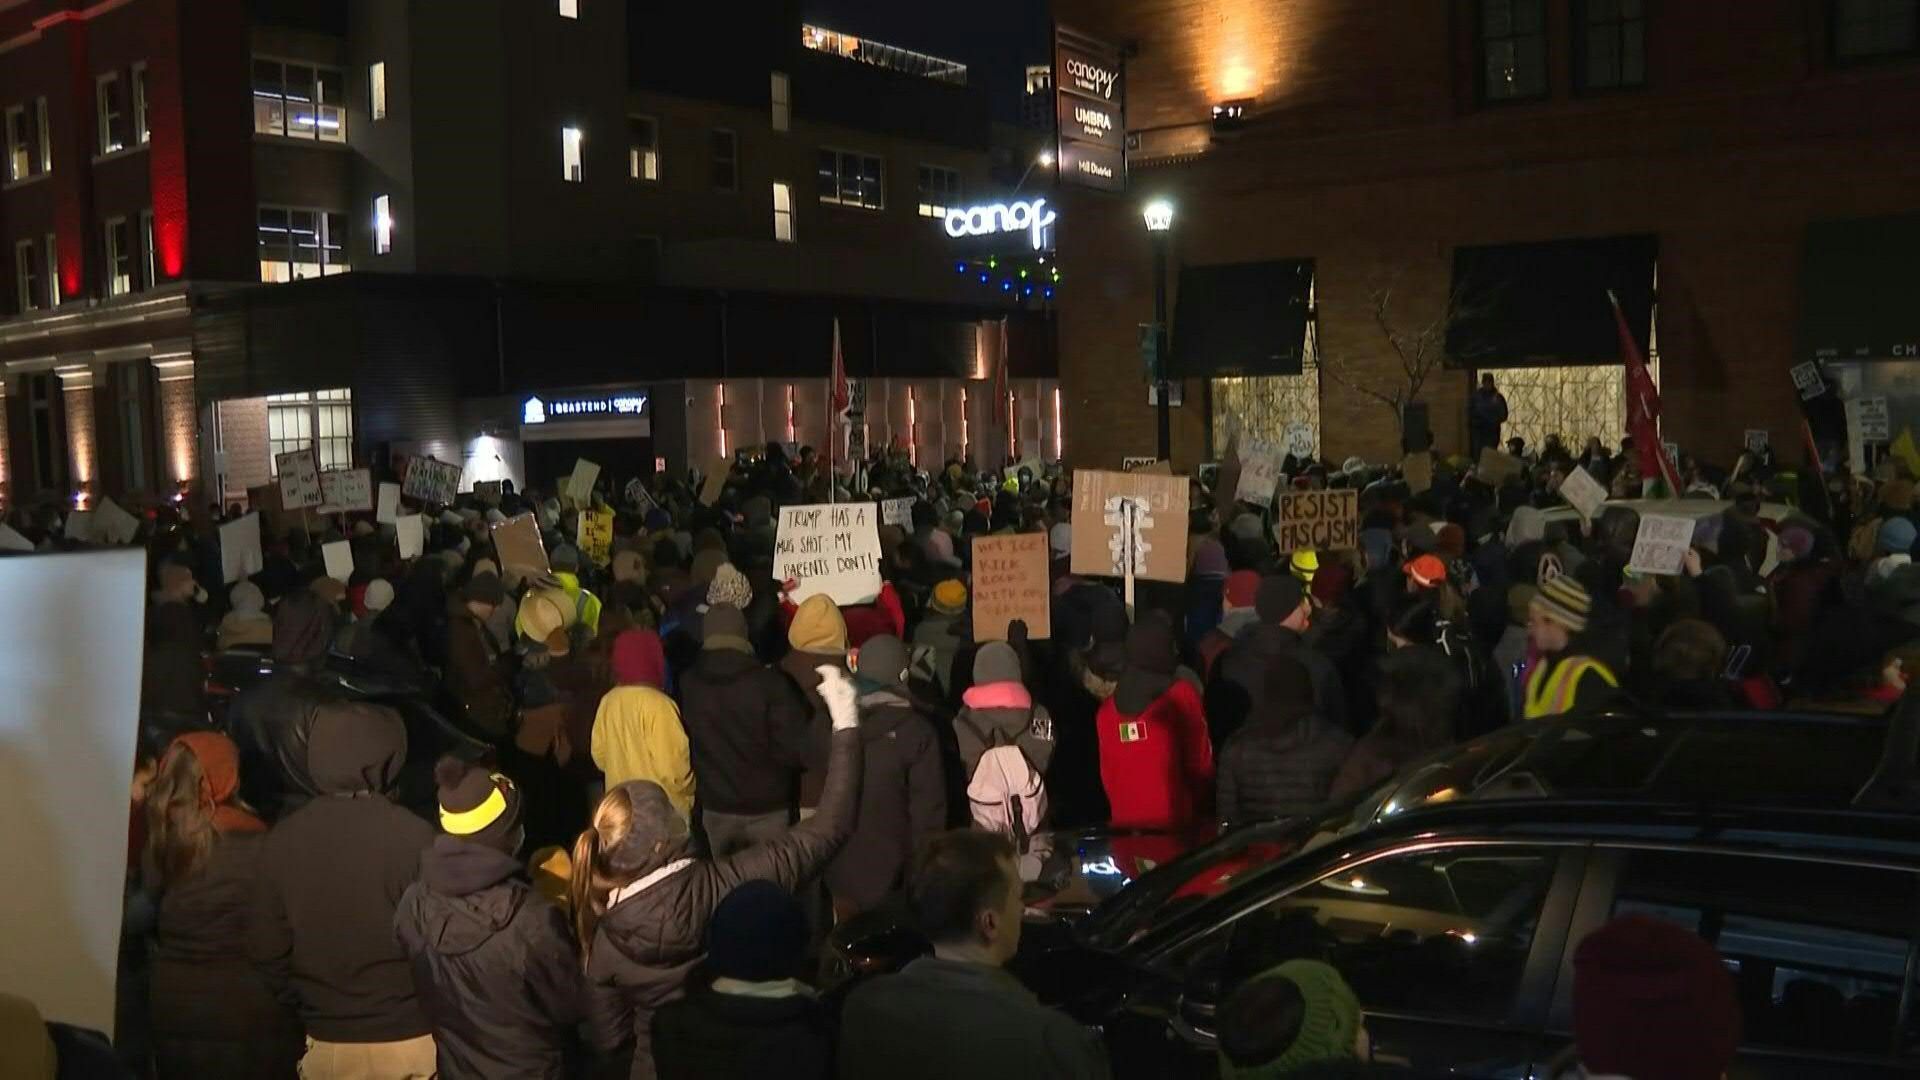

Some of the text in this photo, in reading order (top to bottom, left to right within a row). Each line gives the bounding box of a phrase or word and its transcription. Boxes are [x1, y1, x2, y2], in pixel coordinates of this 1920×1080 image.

[1066, 59, 1119, 100] canopy
[1075, 106, 1112, 131] UMBRA
[1078, 159, 1090, 174] Mill
[788, 508, 822, 530] TRUMP
[831, 506, 849, 528] HAS
[856, 507, 865, 527] A
[1280, 491, 1356, 521] RESIST
[776, 538, 794, 556] MUG
[835, 531, 852, 553] MY
[1281, 519, 1356, 551] FASCISM
[783, 558, 830, 579] PARENTS
